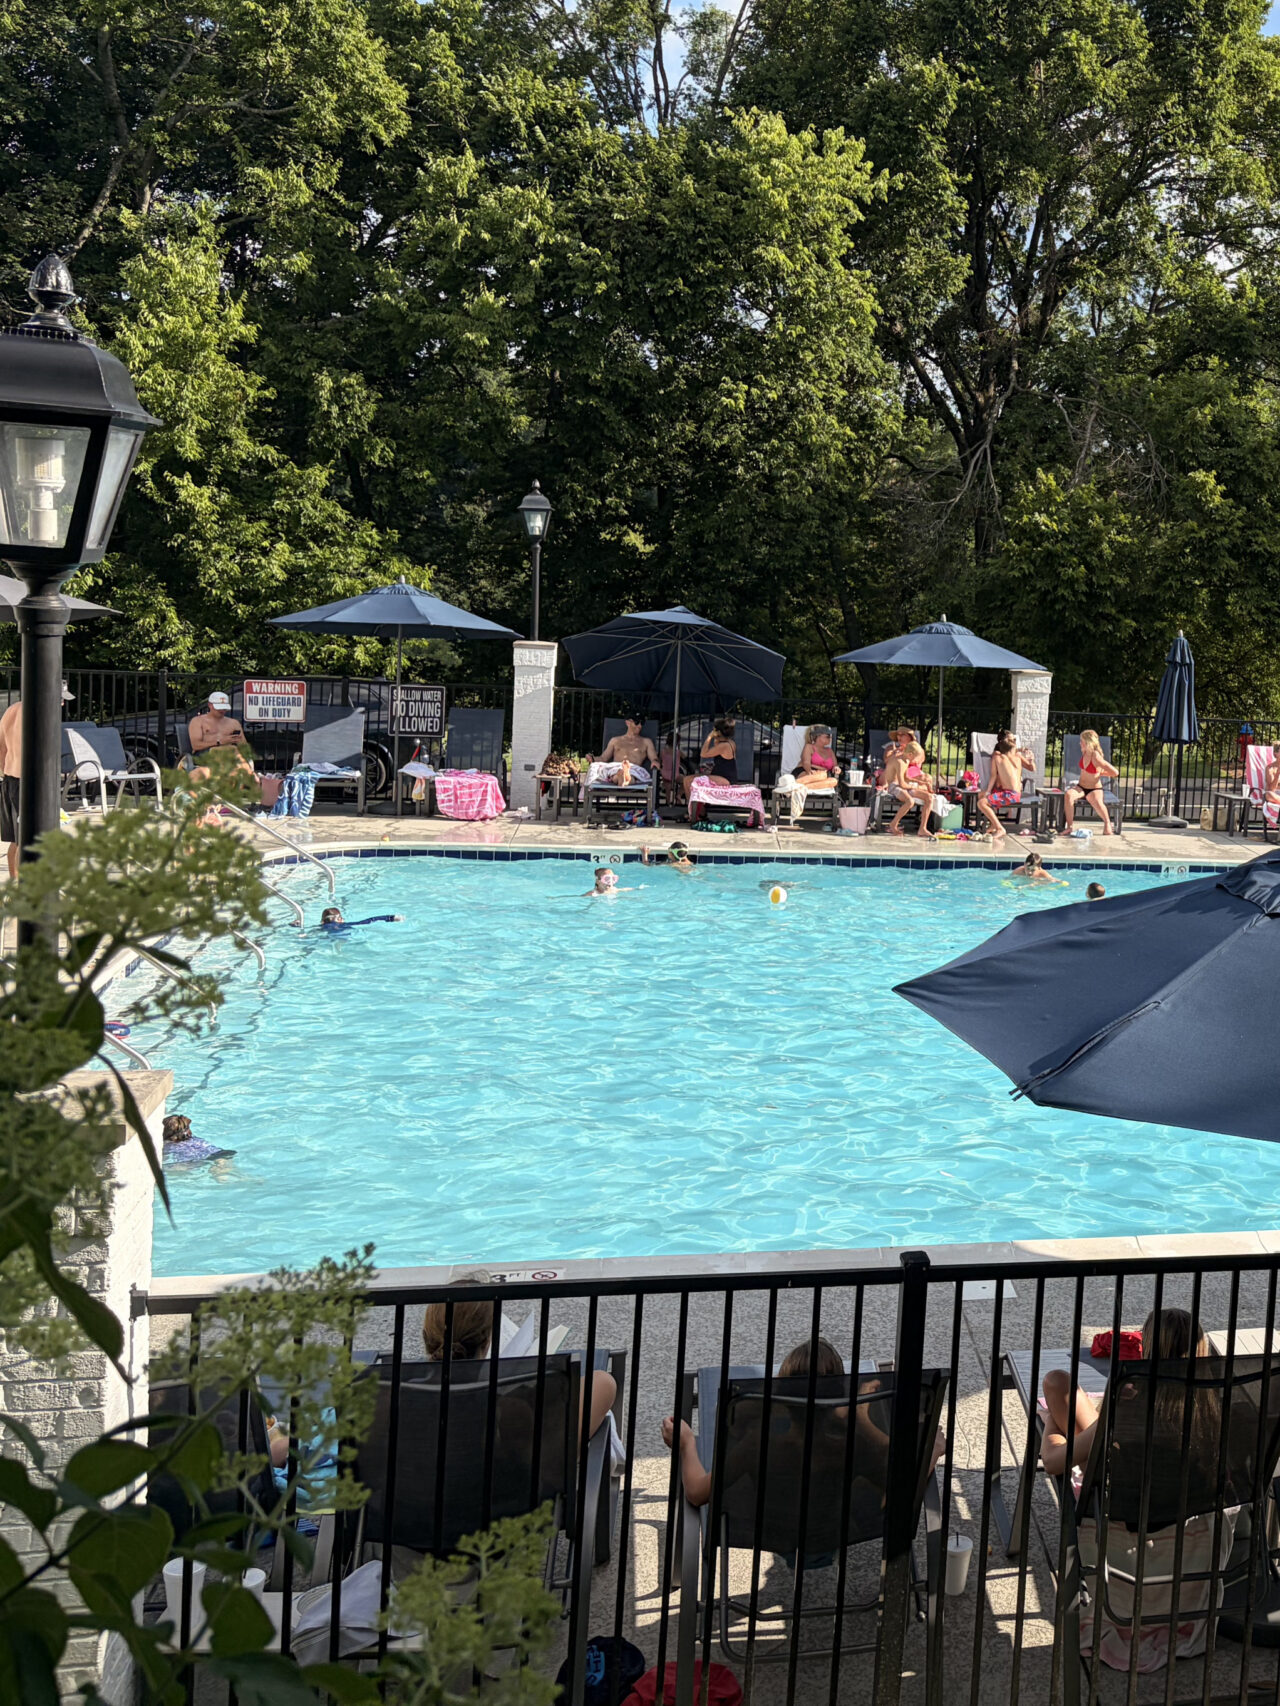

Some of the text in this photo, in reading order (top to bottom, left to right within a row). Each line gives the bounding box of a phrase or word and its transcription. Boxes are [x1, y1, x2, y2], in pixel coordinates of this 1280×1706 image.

[251, 682, 299, 694] WARNING
[248, 695, 302, 707] NO LIFEGUARD
[393, 689, 442, 701] SALLOW WATER
[258, 707, 292, 718] ON DUTY
[408, 701, 441, 717] DIVING
